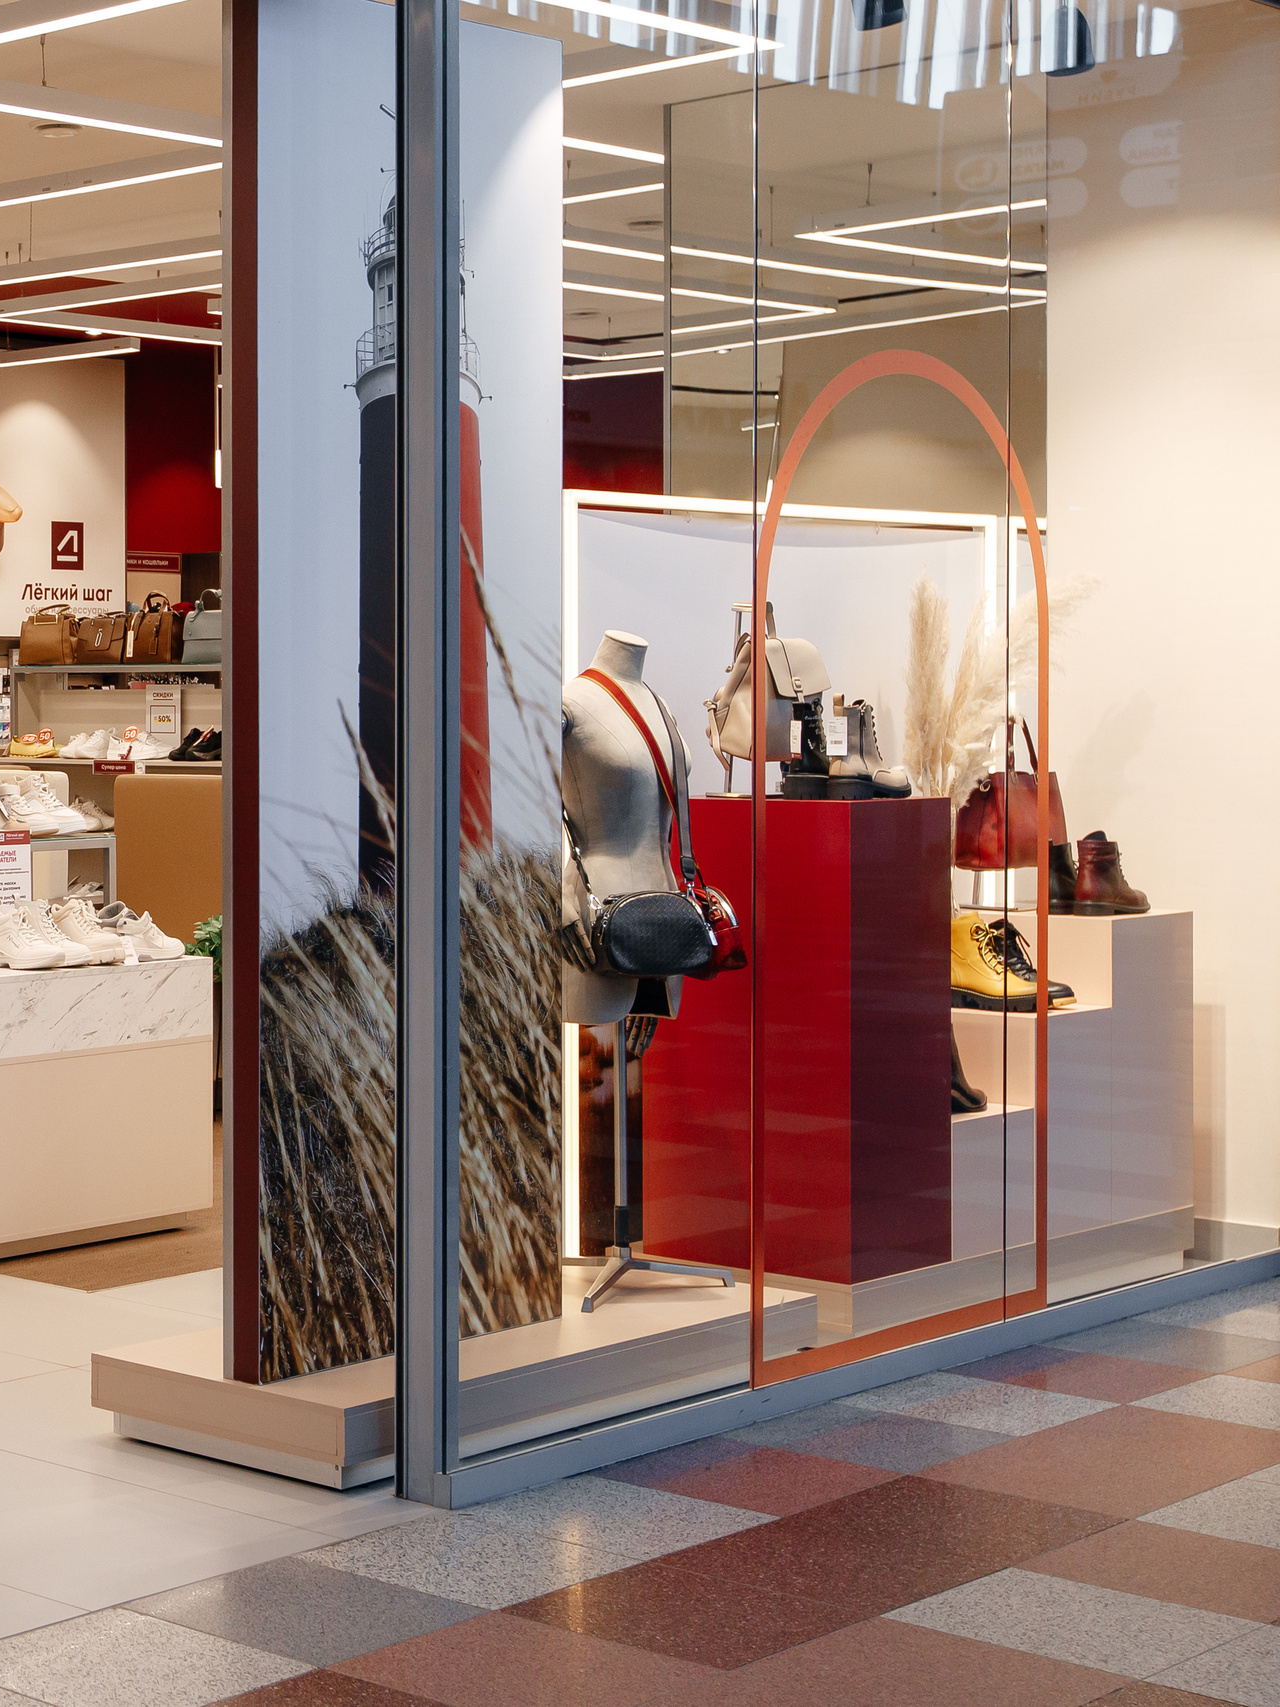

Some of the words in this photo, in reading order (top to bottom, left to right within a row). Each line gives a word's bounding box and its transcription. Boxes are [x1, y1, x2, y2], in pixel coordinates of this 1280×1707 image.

[21, 583, 78, 600] Лёгкий
[83, 588, 113, 602] шаг
[39, 732, 51, 741] 50
[124, 730, 137, 740] 50
